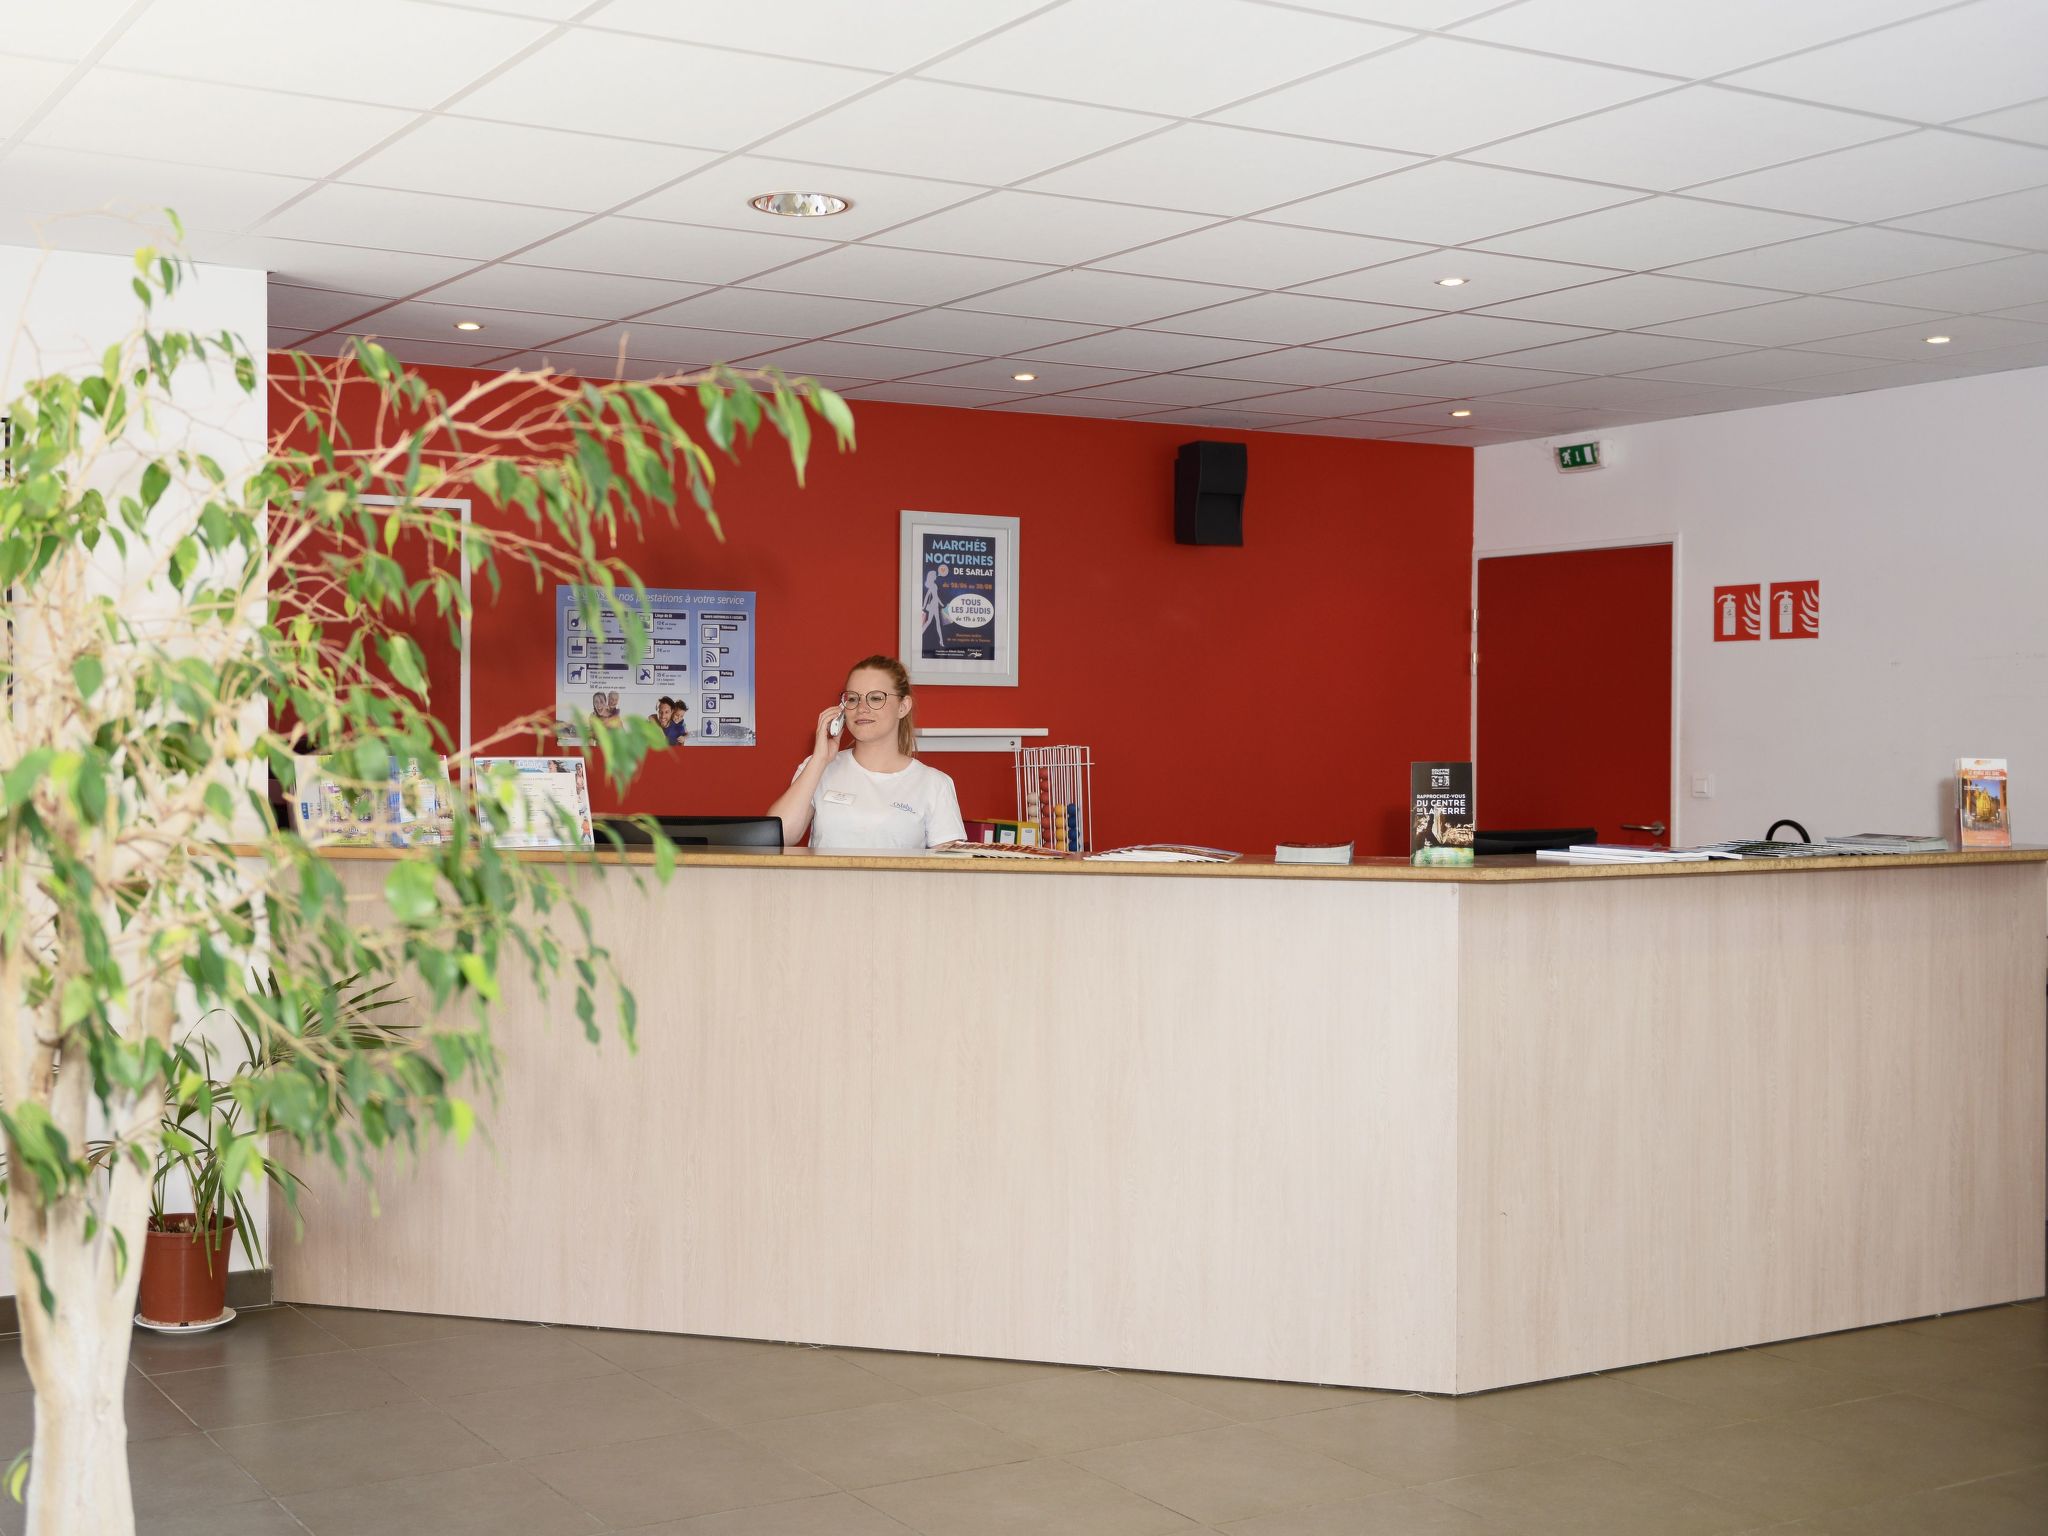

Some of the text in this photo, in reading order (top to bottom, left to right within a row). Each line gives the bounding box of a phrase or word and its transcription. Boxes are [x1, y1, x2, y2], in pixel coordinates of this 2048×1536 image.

[932, 539, 987, 552] MARCHÉS
[925, 552, 994, 567] NOCTURNES
[953, 567, 994, 577] DE SARLAT
[618, 592, 634, 601] nos
[694, 594, 715, 604] votre
[717, 596, 745, 605] service
[960, 598, 981, 606] TOUS
[951, 606, 991, 615] LES JEUDIS
